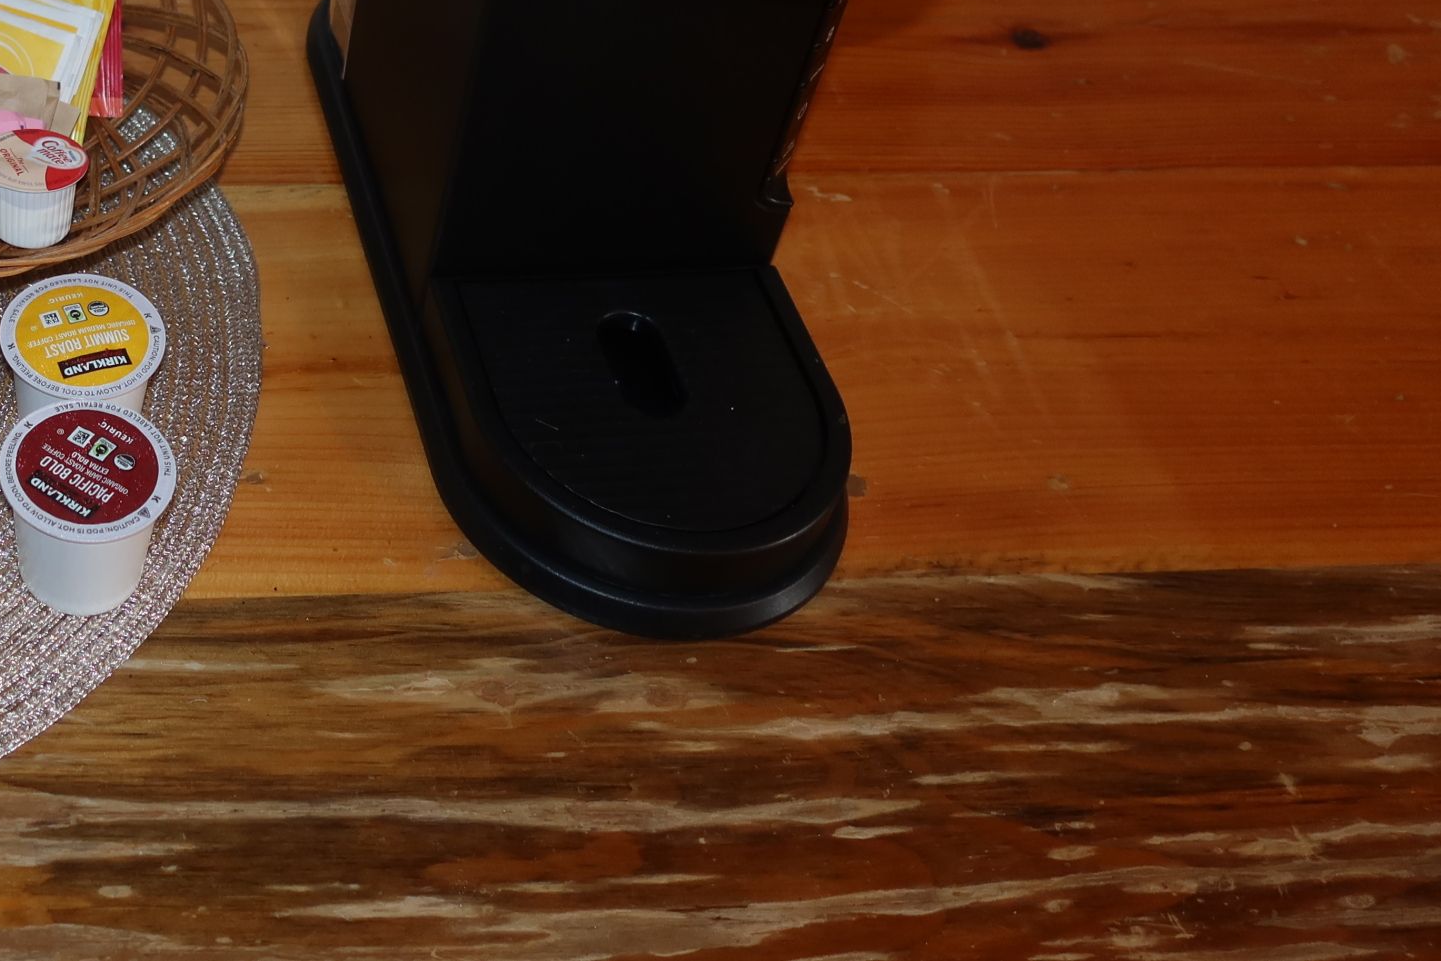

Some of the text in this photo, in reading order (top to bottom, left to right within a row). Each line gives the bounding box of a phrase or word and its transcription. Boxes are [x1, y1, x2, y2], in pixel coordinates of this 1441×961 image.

[0, 148, 24, 176] ORIGINAL
[49, 293, 82, 303] KEURIG
[119, 288, 134, 299] THIS
[45, 329, 130, 358] SUMMIT ROAST
[64, 356, 127, 376] KIRKLAND
[142, 362, 153, 374] POD
[33, 377, 60, 392] BEFORE
[97, 385, 121, 394] ALLOW
[56, 403, 74, 412] SALE
[106, 403, 122, 412] FOR
[122, 409, 152, 430] LABELED
[98, 421, 134, 444] KEURIG
[151, 430, 163, 443] NOT
[72, 452, 88, 464] BOLD
[160, 444, 170, 461] UNIT
[5, 460, 14, 484] BEFORE
[42, 443, 128, 494] ORGANIC DARK ROAST COFFEE
[89, 462, 109, 474] EXTRA
[40, 456, 114, 502] PACIFIC BOLD
[11, 484, 24, 502] COOL
[30, 478, 91, 516] KIRKLAND
[23, 502, 30, 510] TO
[32, 510, 56, 526] ALLOW
